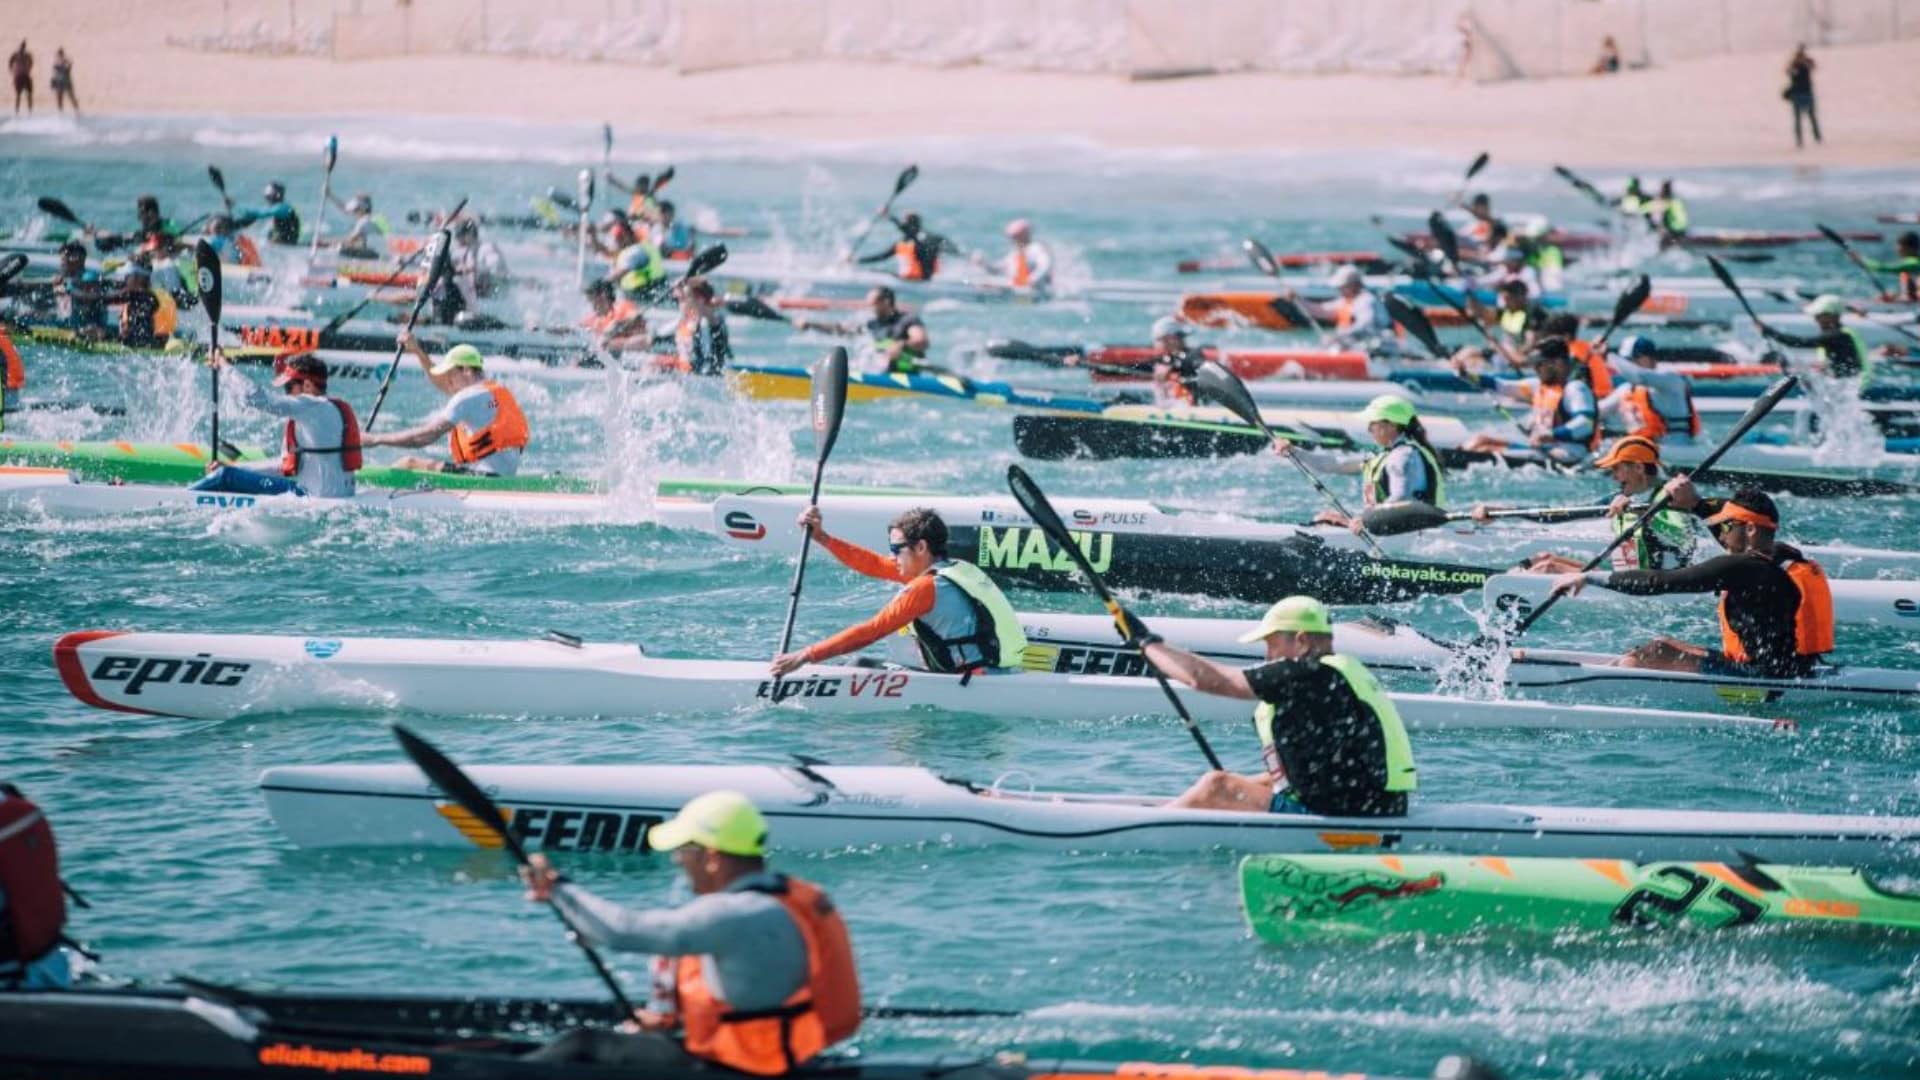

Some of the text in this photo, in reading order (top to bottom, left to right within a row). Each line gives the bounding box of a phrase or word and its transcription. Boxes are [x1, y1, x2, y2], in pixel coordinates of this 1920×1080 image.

[1102, 511, 1149, 525] PULSE
[1361, 563, 1487, 584] eliokayaks.com
[91, 654, 250, 695] epic
[850, 674, 909, 697] V12
